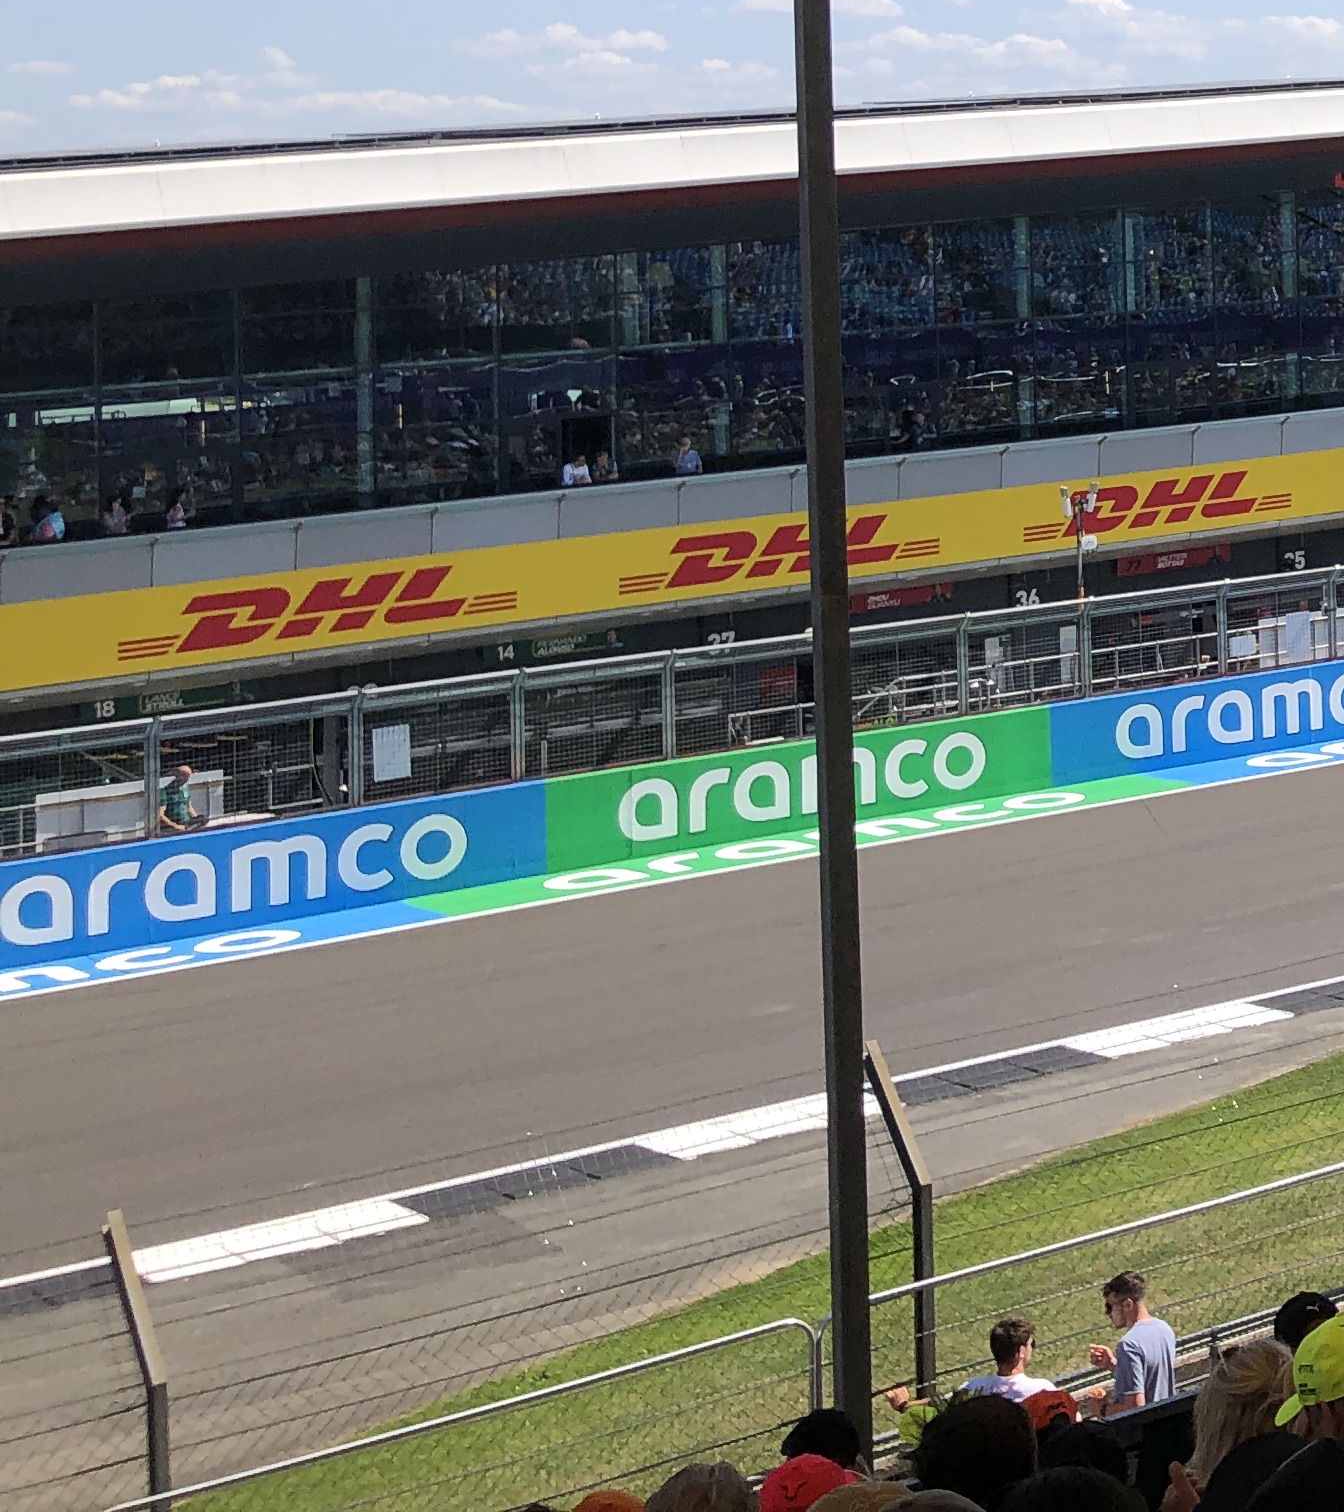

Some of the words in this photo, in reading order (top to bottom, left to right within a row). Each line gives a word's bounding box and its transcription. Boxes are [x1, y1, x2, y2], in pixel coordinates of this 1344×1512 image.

[1062, 471, 1258, 537] DHL
[666, 515, 900, 588] DHL
[176, 565, 467, 653] DHL
[1015, 588, 1040, 606] 36
[497, 643, 515, 661] 14
[94, 699, 116, 718] 18
[618, 732, 986, 842] aramco
[0, 814, 468, 946] aramco
